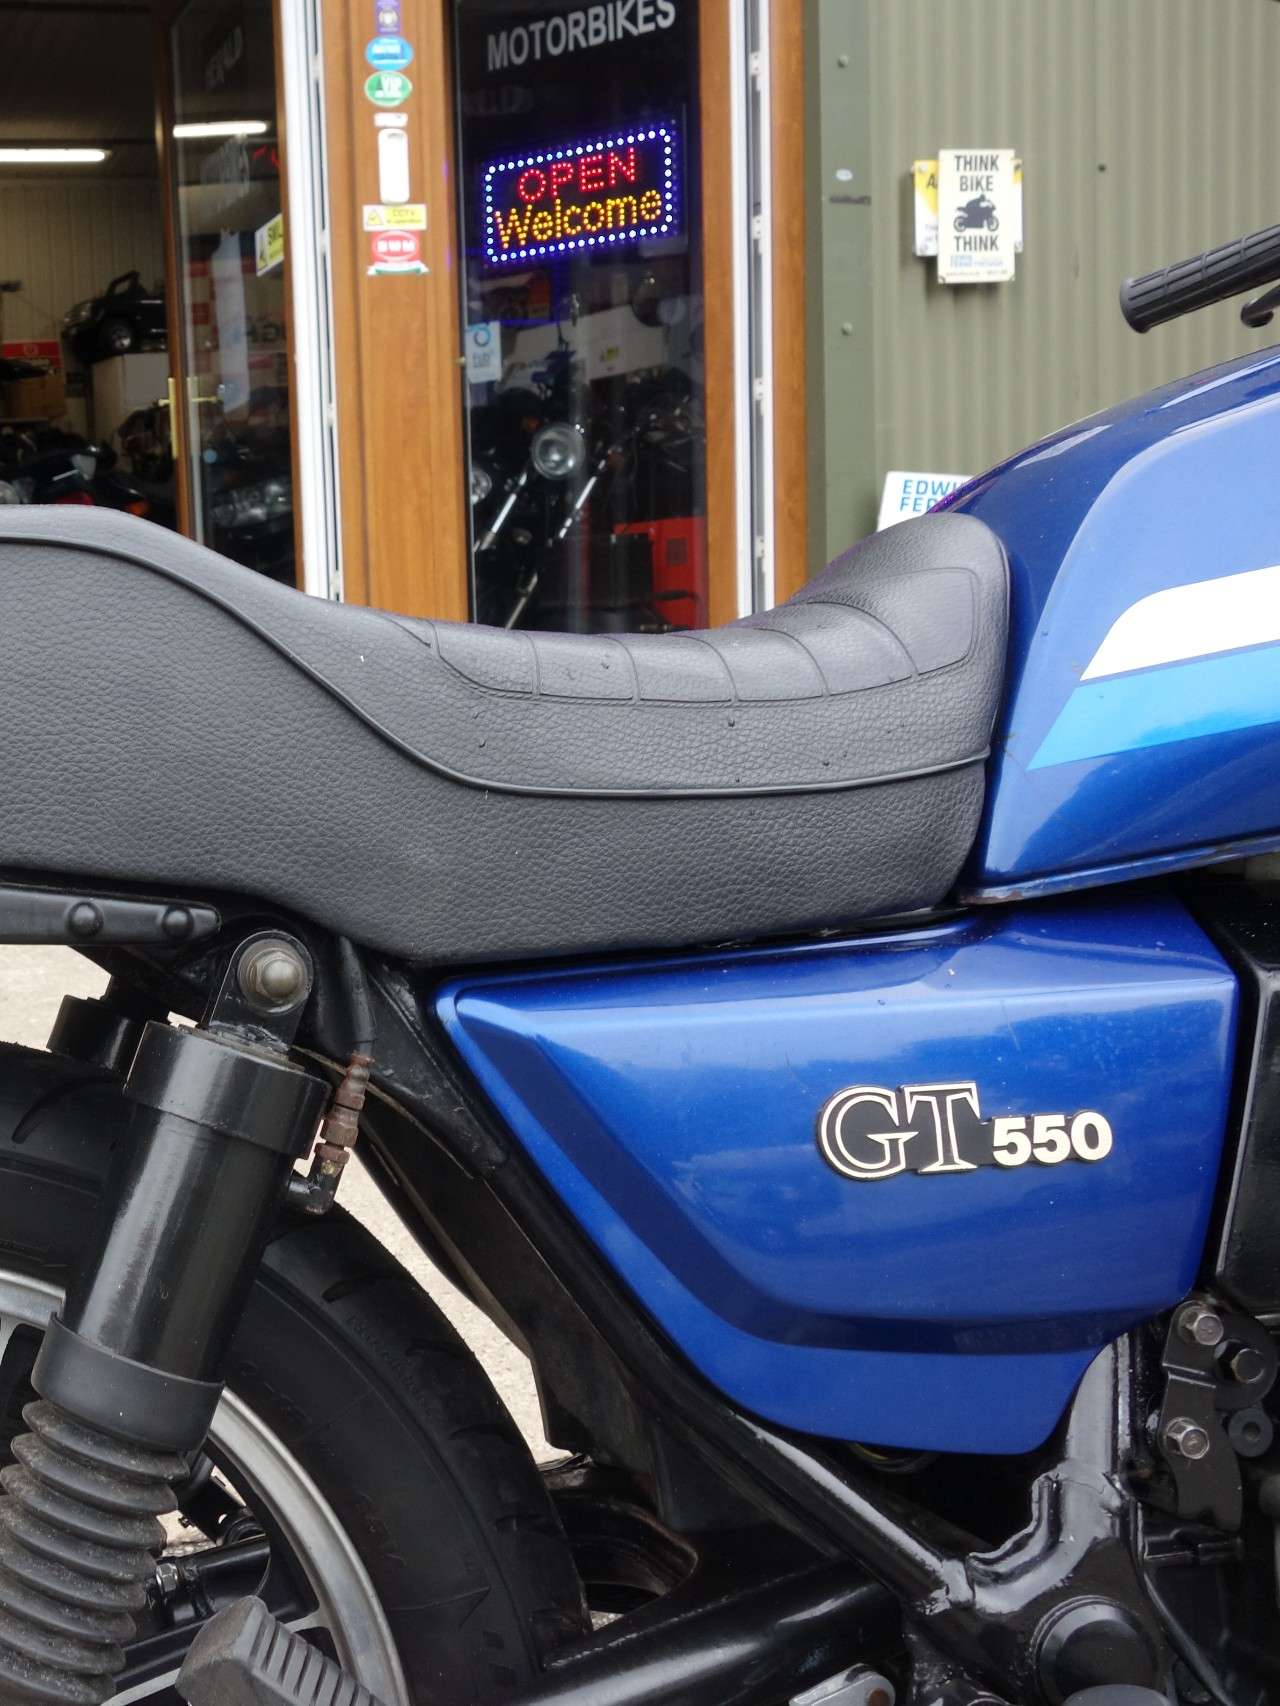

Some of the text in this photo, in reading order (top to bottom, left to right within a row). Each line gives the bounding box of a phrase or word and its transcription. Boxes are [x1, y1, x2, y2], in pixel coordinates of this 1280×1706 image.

[487, 0, 677, 72] MOTORBIKES
[517, 146, 637, 203] OPEN
[954, 154, 1000, 172] THINK
[959, 175, 995, 192] BIKE
[493, 188, 664, 250] Welcome
[953, 235, 999, 252] THINK
[902, 479, 965, 496] EDWI
[817, 1081, 1114, 1180] GT 550
